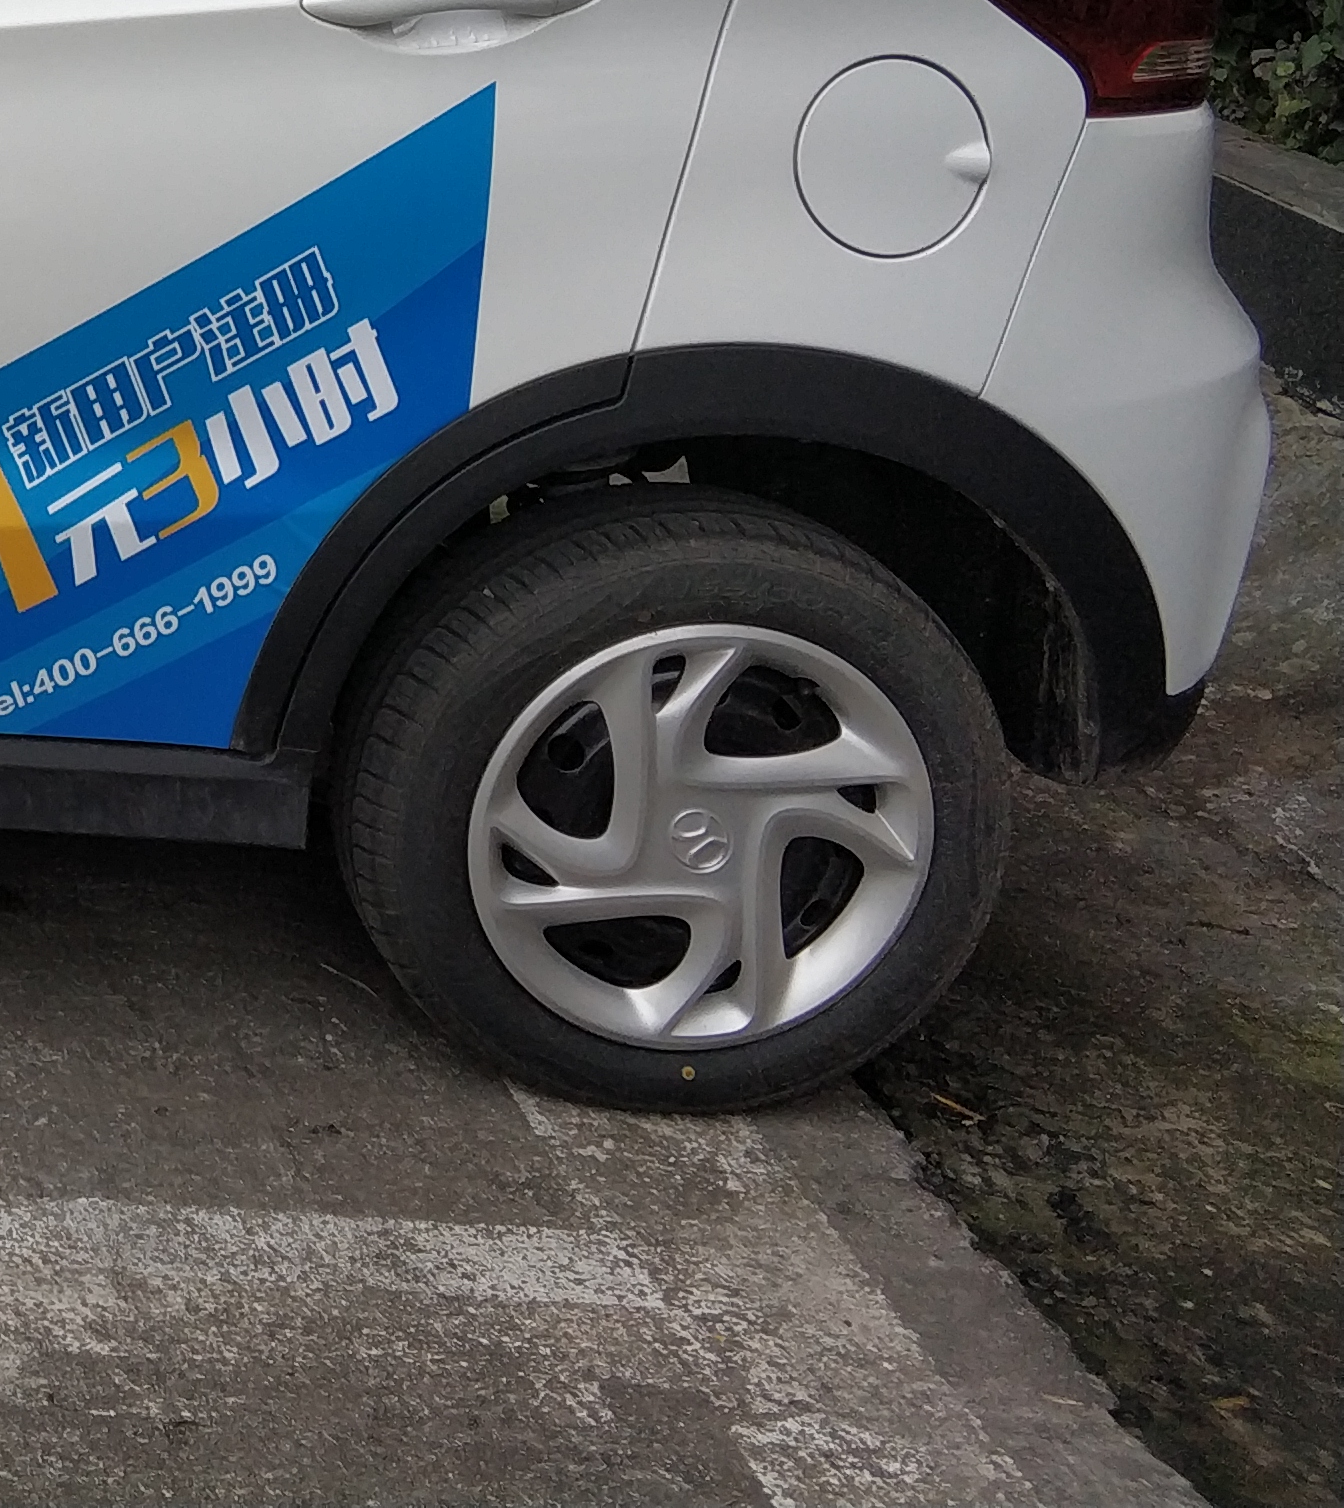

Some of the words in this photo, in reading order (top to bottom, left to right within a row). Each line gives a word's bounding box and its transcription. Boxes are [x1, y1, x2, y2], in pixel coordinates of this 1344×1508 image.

[2, 246, 339, 490] 新用户注册
